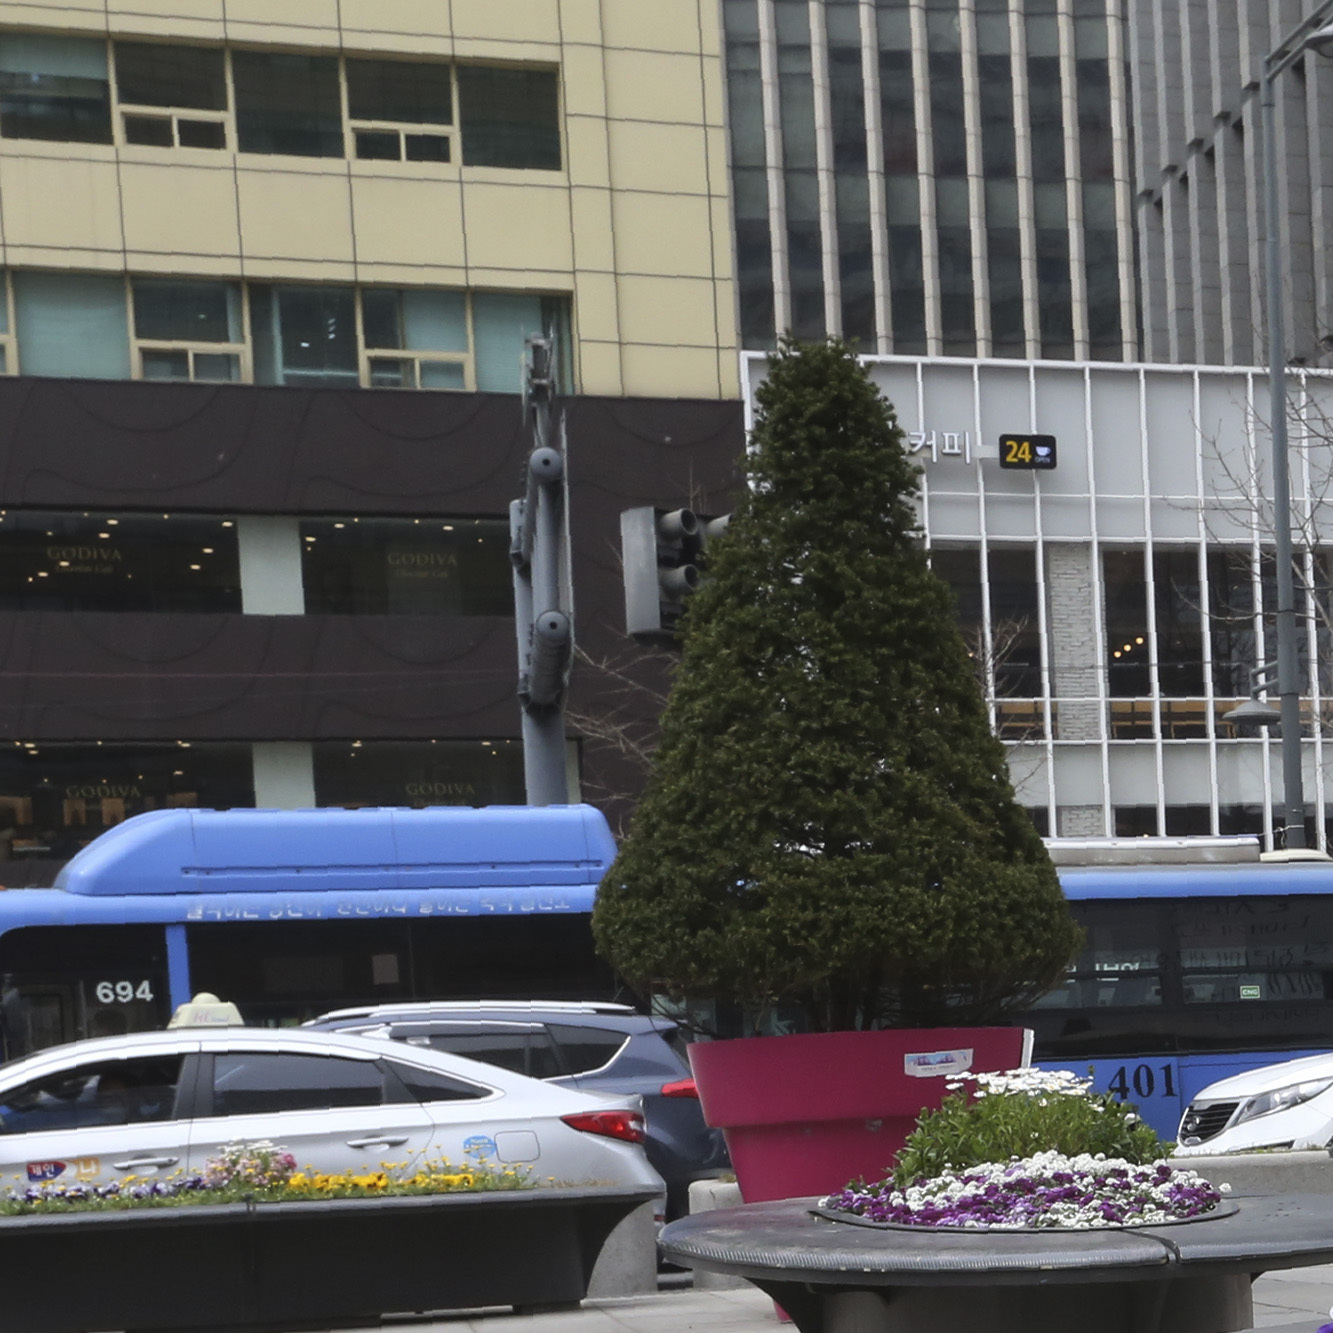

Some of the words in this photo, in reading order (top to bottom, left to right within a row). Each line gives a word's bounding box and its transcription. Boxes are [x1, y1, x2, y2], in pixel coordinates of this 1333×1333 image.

[1005, 440, 1032, 463] 24
[1034, 456, 1051, 464] OPEN
[46, 546, 122, 562] GODIVA
[387, 552, 458, 567] GODIVA
[66, 785, 141, 798] GODIVA
[405, 782, 475, 795] GODIVA
[96, 979, 154, 1004] 694
[1242, 988, 1258, 997] CNG
[1107, 1063, 1178, 1099] 401
